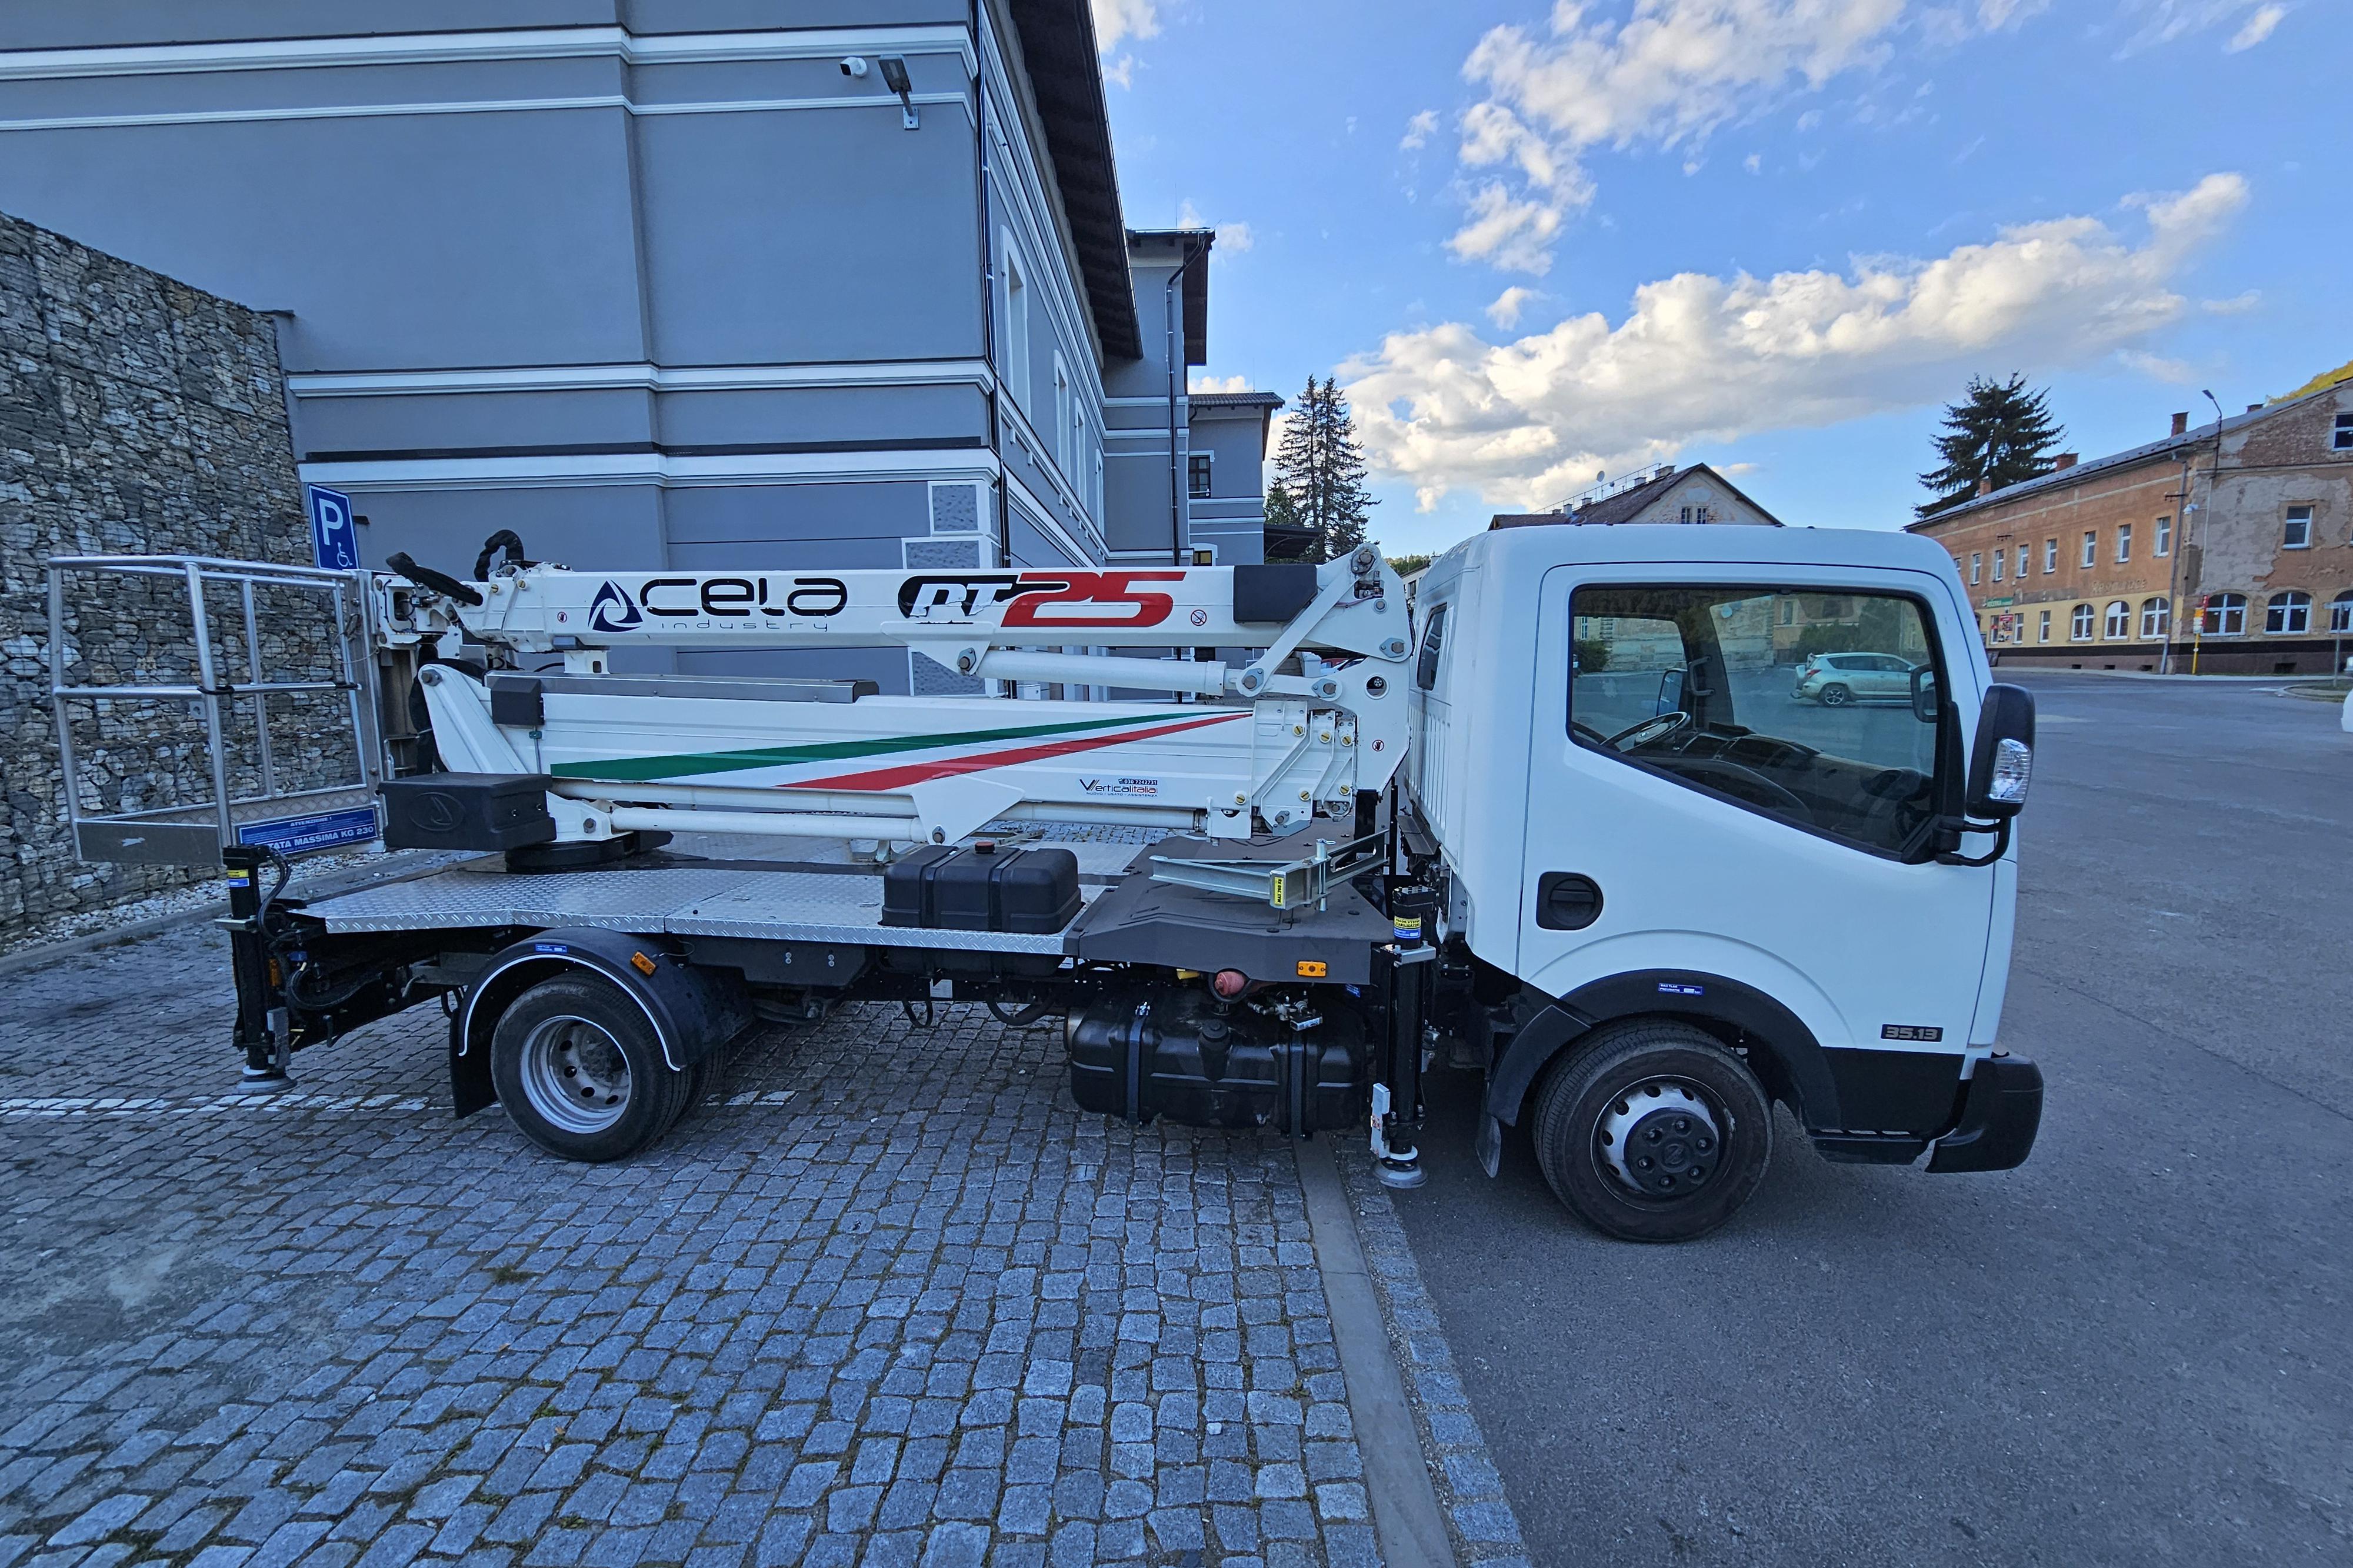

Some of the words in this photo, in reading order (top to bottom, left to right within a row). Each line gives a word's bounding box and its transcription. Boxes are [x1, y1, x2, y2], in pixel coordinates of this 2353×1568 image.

[318, 498, 344, 546] P
[661, 619, 828, 632] industry
[294, 832, 339, 846] MASSIMA
[341, 829, 354, 838] KG
[356, 826, 374, 835] 230
[1885, 1026, 1938, 1040] 35.13
